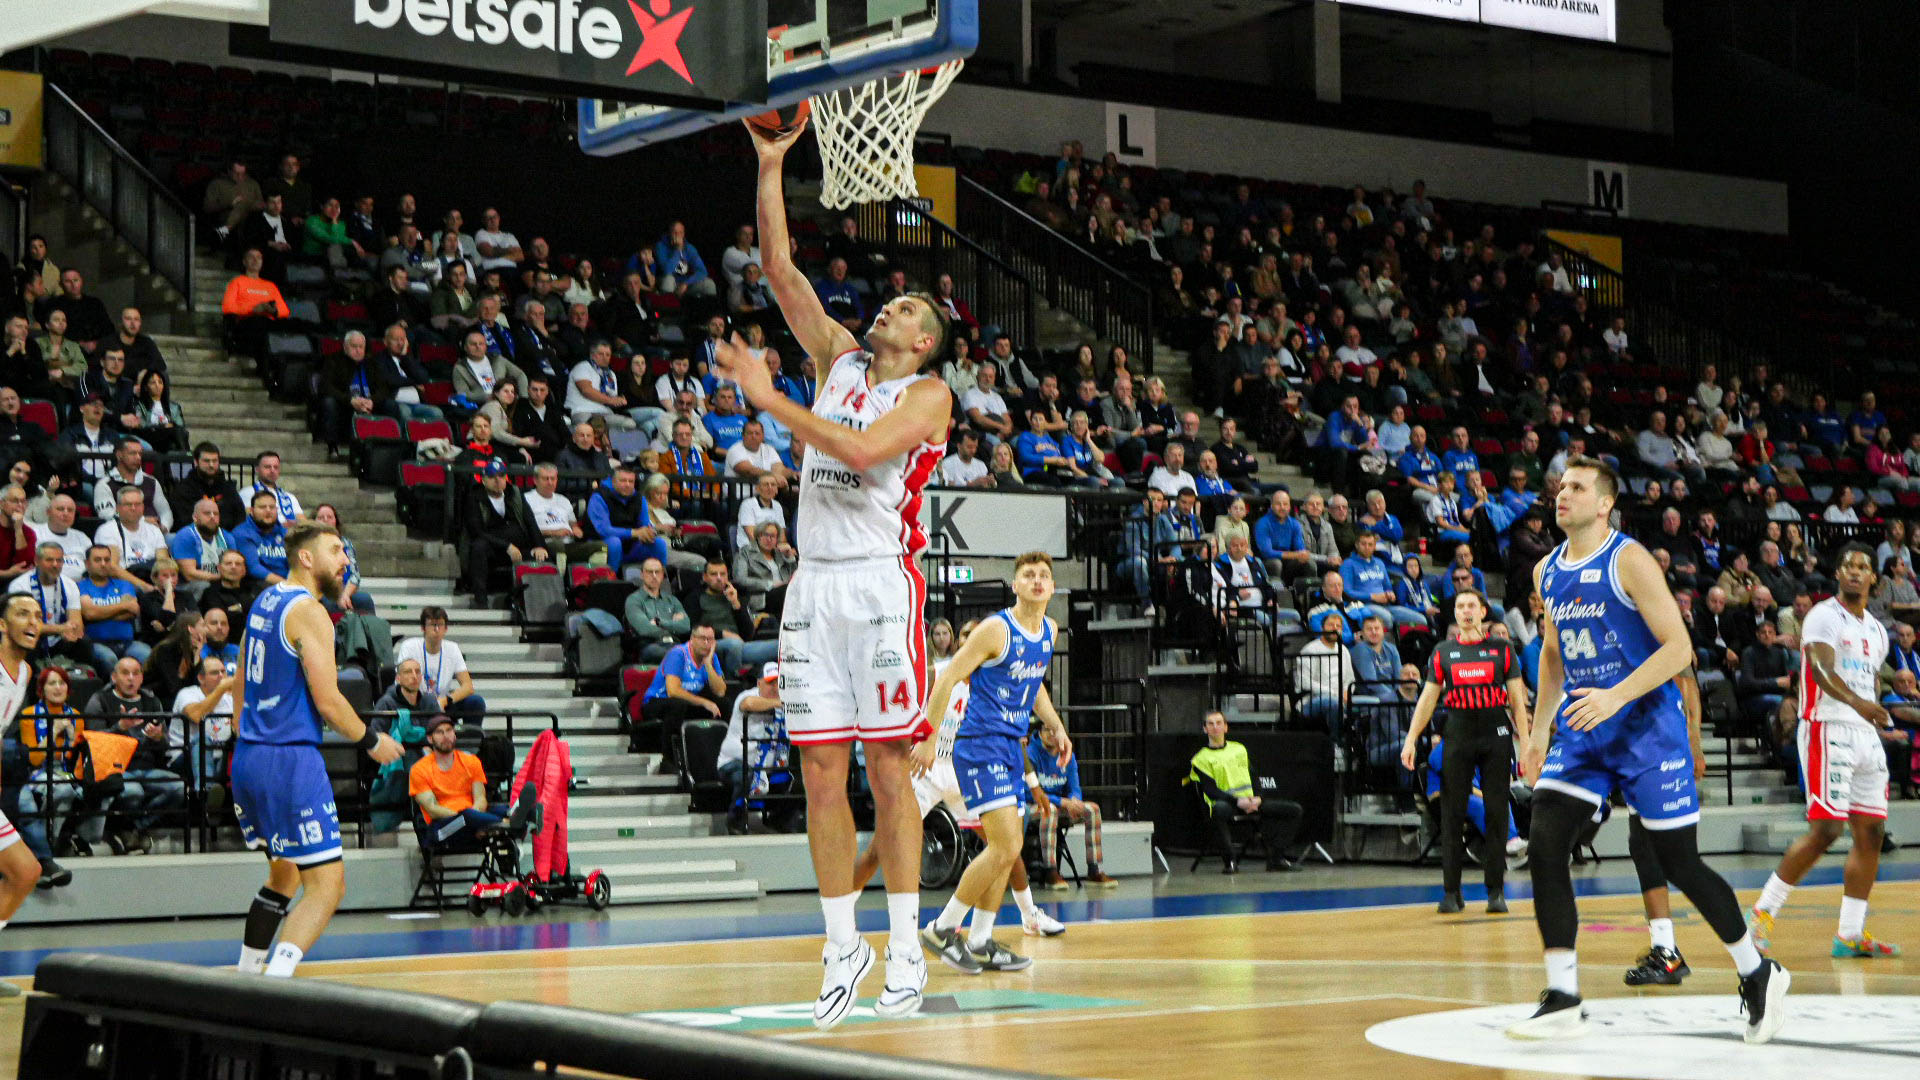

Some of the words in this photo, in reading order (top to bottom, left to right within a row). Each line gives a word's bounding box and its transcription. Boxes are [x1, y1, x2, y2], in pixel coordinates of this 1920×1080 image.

[1561, 0, 1600, 15] ARENA
[1119, 114, 1143, 157] L
[1593, 170, 1623, 210] M
[811, 468, 861, 490] UTENOS
[930, 496, 970, 551] K
[246, 636, 266, 685] 13
[1560, 628, 1598, 660] 34
[876, 678, 911, 715] 14
[298, 819, 324, 847] 13
